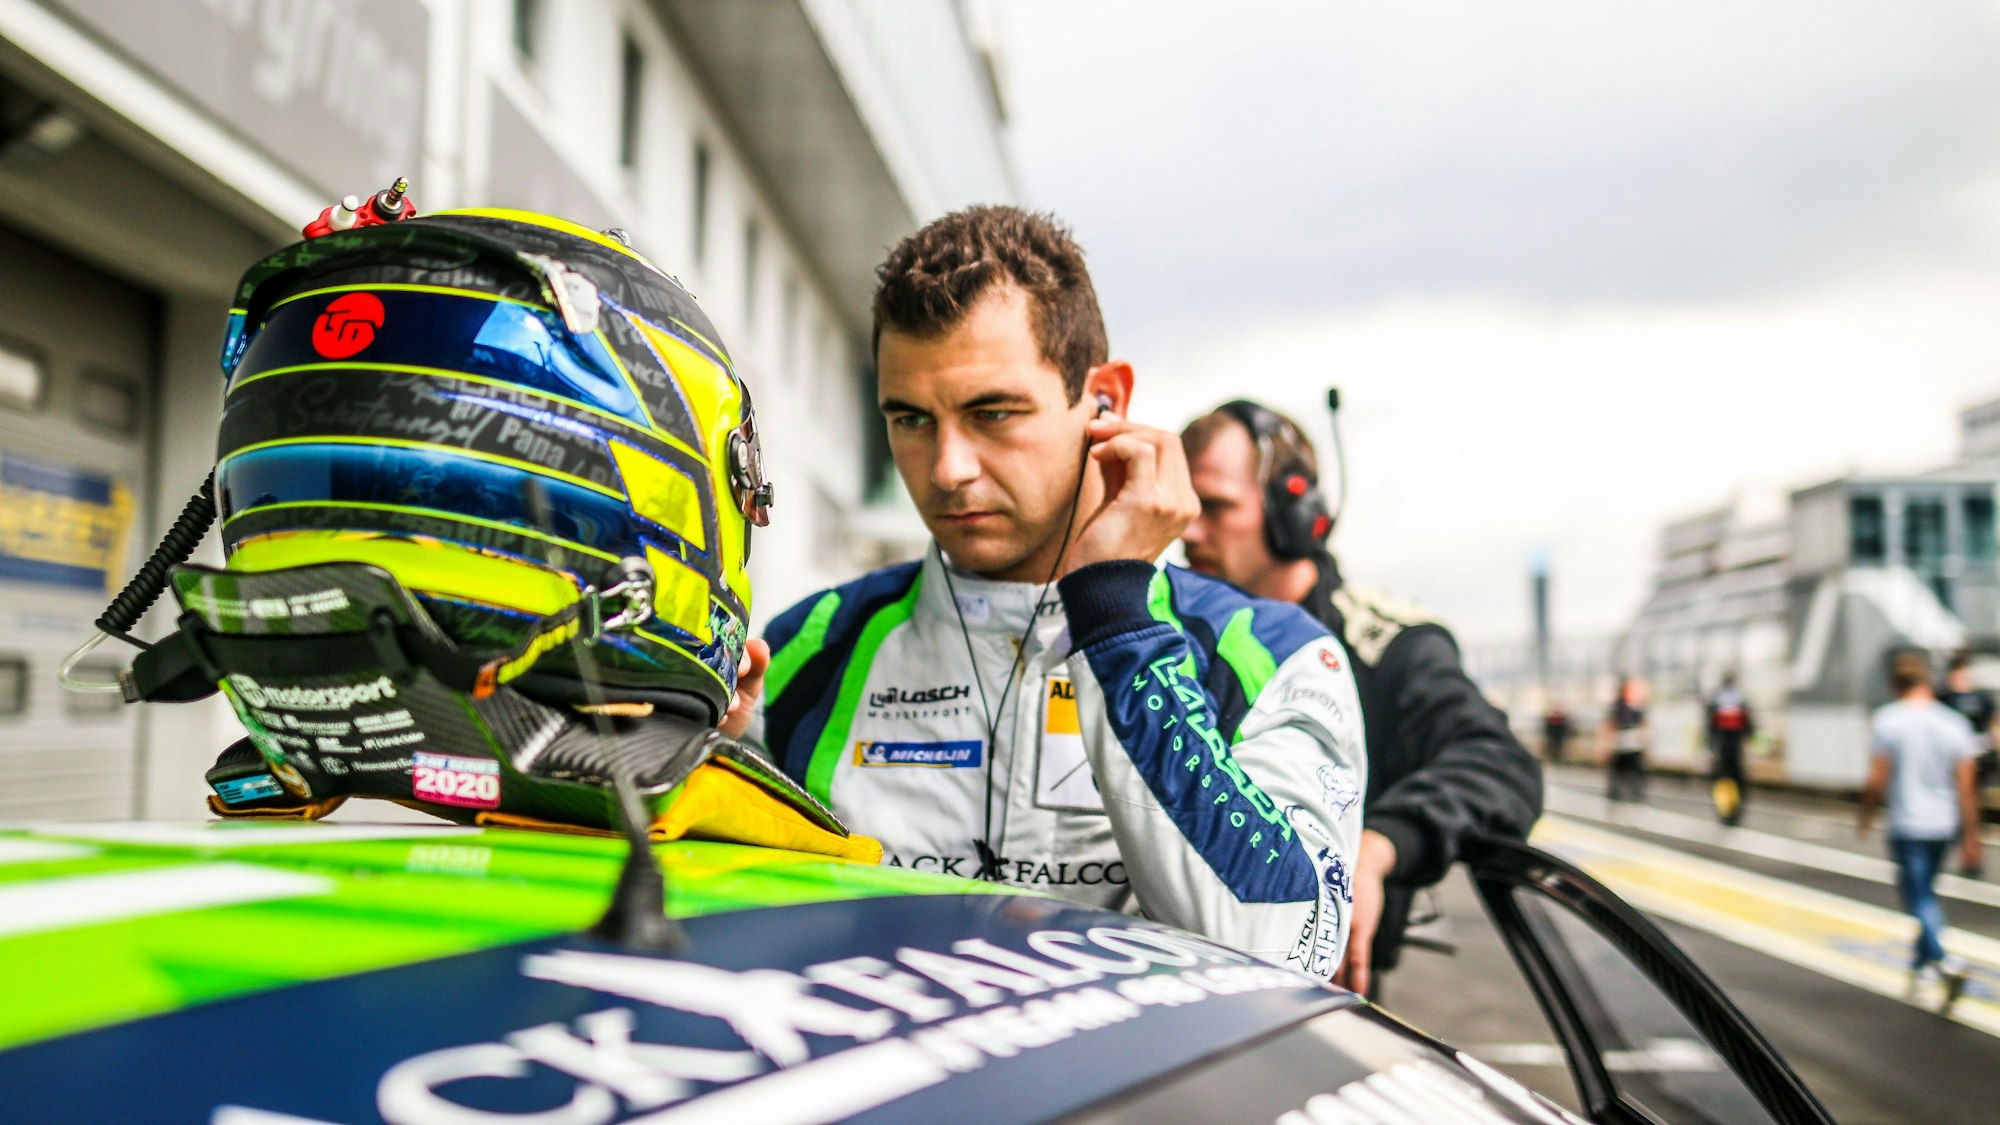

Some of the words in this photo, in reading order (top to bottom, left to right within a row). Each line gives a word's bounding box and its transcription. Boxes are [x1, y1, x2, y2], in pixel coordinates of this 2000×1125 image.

[495, 416, 567, 470] Papa
[263, 675, 398, 710] motorsport
[900, 685, 970, 705] LOSCH
[867, 707, 971, 720] MOTORSPORT
[889, 748, 972, 762] MICHELIN
[1132, 672, 1281, 865] MOTORSPORT
[414, 767, 500, 801] 2020
[889, 854, 966, 880] ACK
[1015, 860, 1129, 886] FALCO
